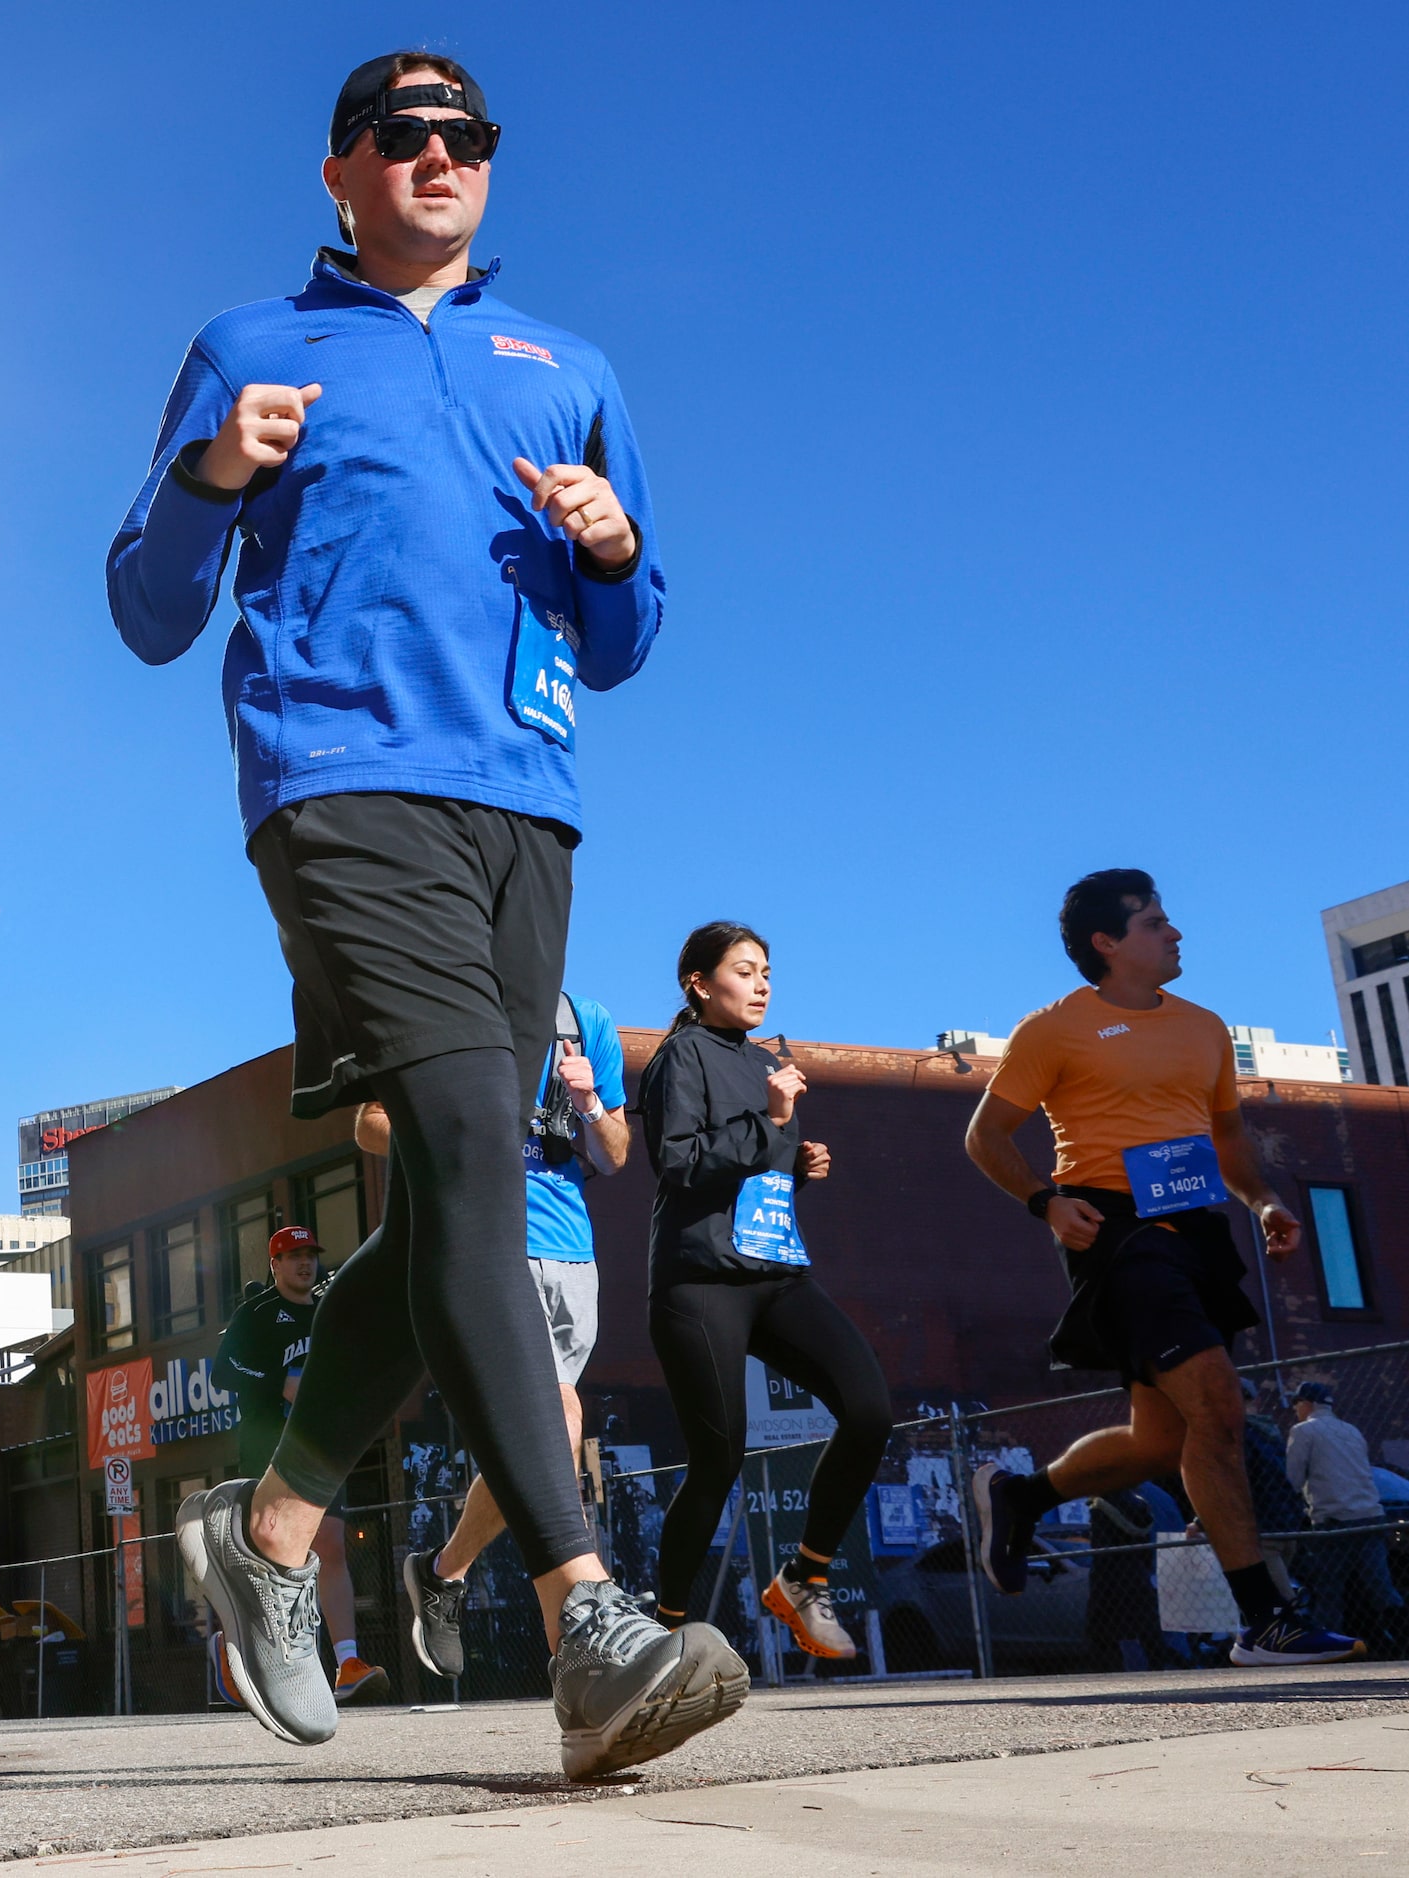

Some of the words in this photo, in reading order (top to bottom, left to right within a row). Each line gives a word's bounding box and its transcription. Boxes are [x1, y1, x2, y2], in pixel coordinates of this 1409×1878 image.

[490, 335, 552, 359] SMU
[535, 668, 548, 698] A
[523, 705, 542, 720] HALF
[309, 746, 347, 758] DRI-FIT
[1097, 1023, 1131, 1039] HOKA
[1150, 1183, 1165, 1198] B
[1168, 1175, 1207, 1194] 14021
[752, 1208, 765, 1223] A
[149, 1358, 185, 1421] all
[101, 1396, 137, 1436] good
[149, 1408, 233, 1445] KITCHENS
[747, 1417, 803, 1433] AVIDSON
[107, 1420, 142, 1448] eats
[109, 1495, 130, 1504] TIME
[110, 1487, 128, 1495] ANY
[747, 1490, 778, 1513] 214
